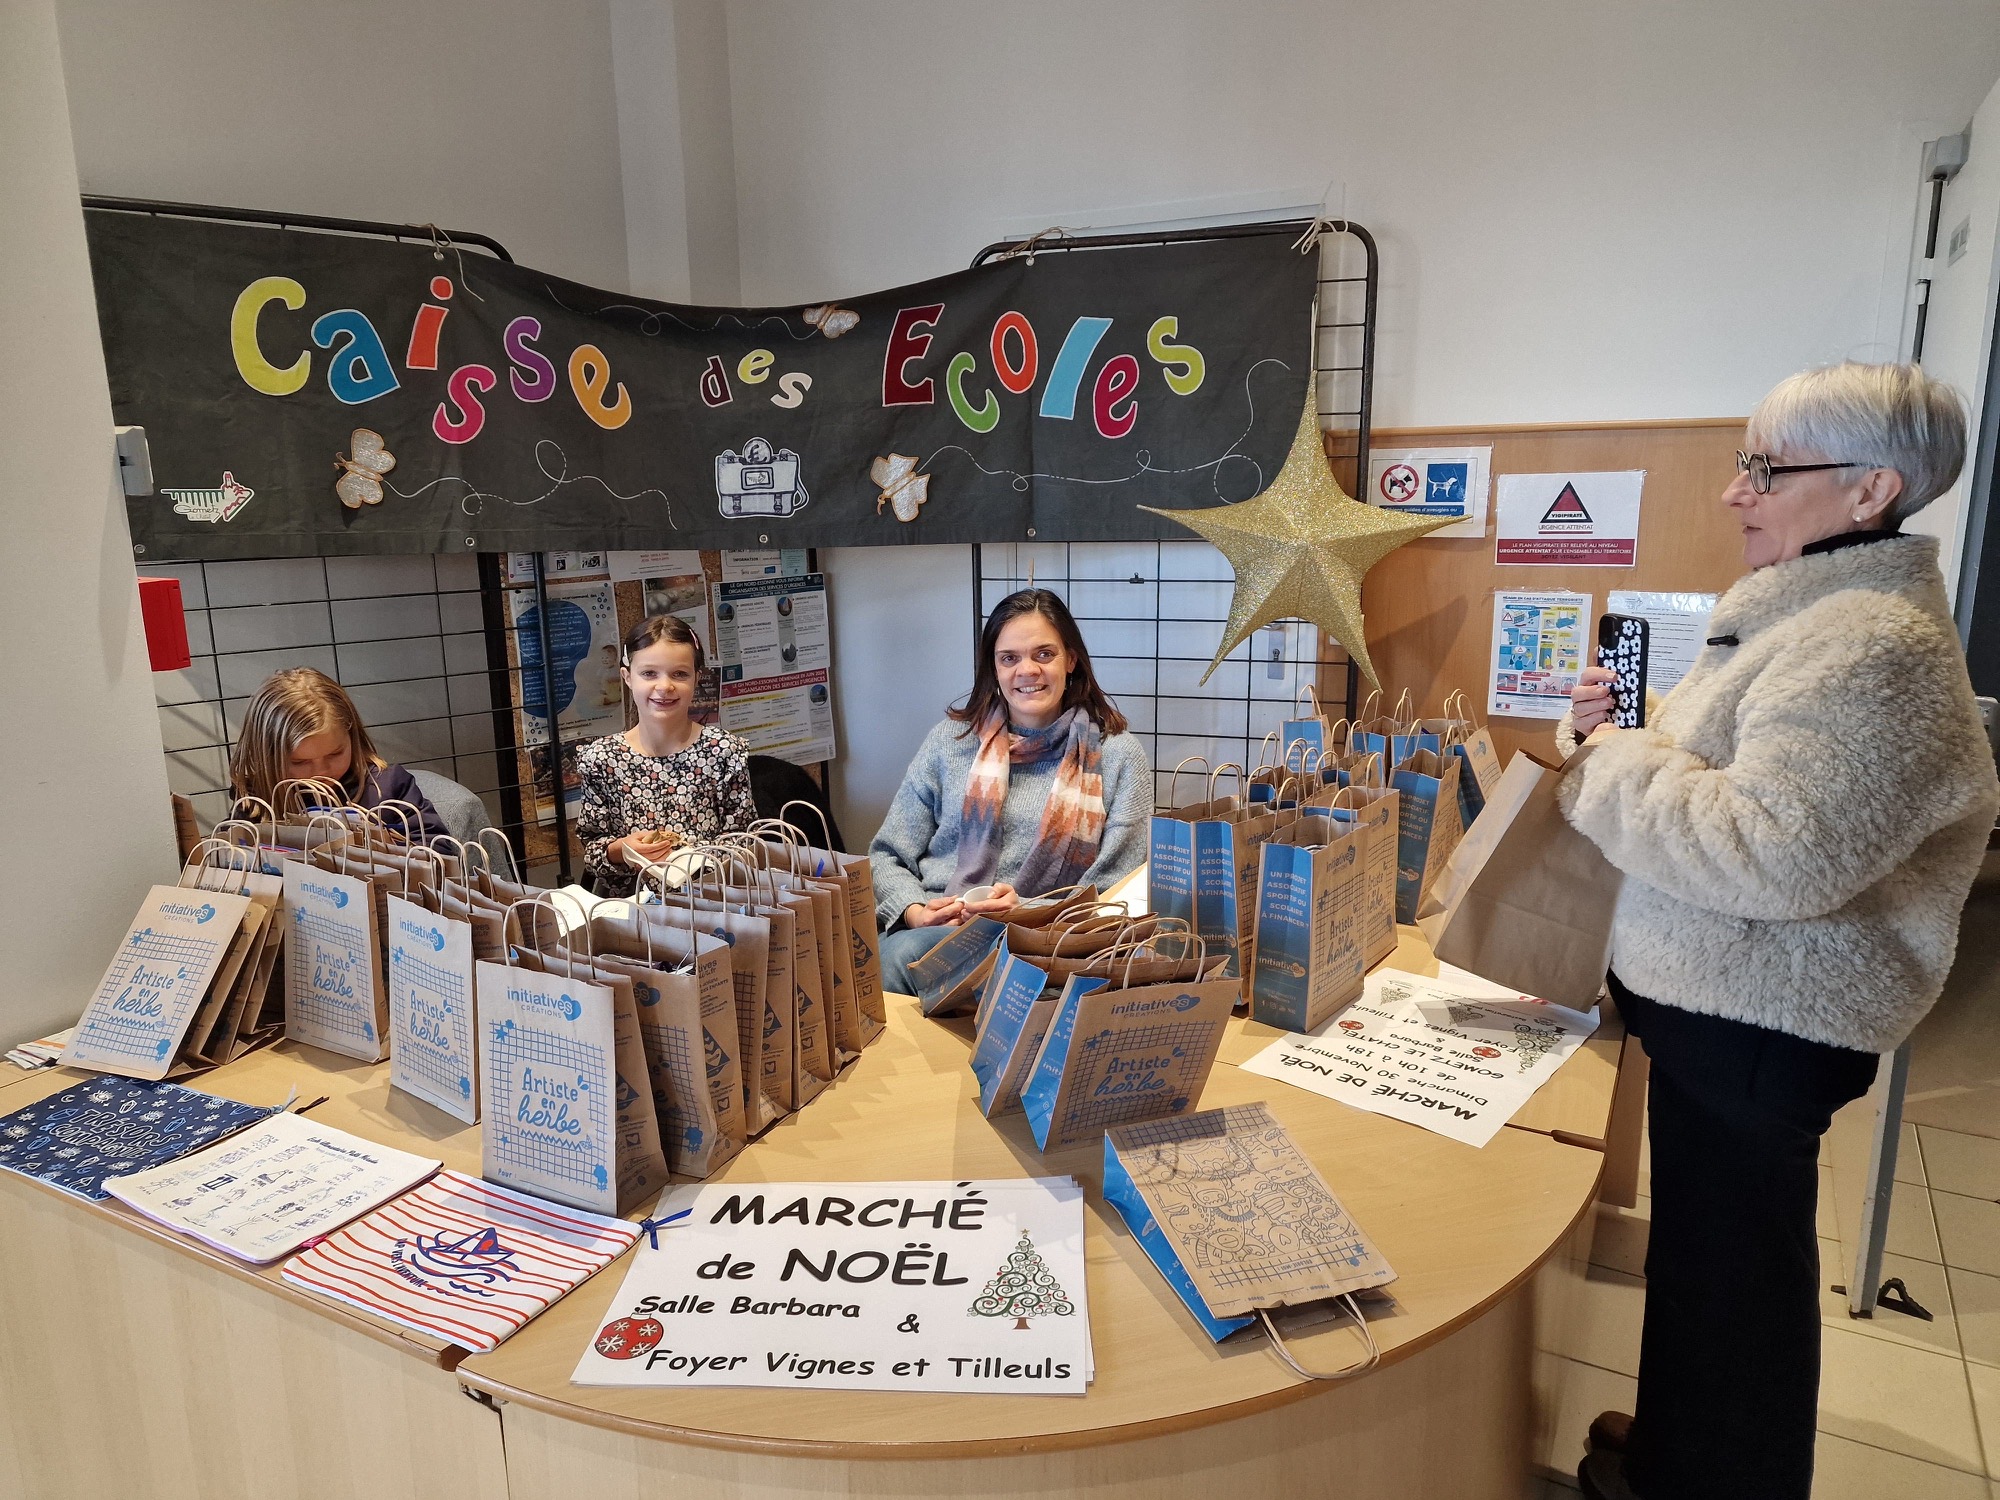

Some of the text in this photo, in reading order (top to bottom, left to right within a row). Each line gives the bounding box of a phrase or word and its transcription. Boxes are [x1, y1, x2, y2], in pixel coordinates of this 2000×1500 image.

[230, 275, 1206, 444] Caisse des Ecoles
[301, 880, 341, 903] initiatives
[159, 901, 209, 918] initiatives
[400, 917, 438, 944] initiatives
[316, 945, 351, 972] Artiste
[129, 964, 175, 990] Artiste
[313, 966, 354, 998] herbe
[328, 968, 339, 979] en
[1013, 980, 1026, 991] UN
[112, 987, 164, 1017] herbe
[138, 988, 150, 998] en
[410, 990, 445, 1022] Artiste
[507, 986, 572, 1014] initiatives
[1005, 993, 1029, 1010] SPOR
[1111, 998, 1190, 1015] initiatives
[422, 1017, 433, 1028] en
[521, 1003, 562, 1019] CRÉATIONS
[1124, 1008, 1172, 1019] CRÉATIONS
[410, 1013, 450, 1050] herbe
[1351, 1004, 1520, 1054] Foyer Vignes et Tilleuls
[1342, 1028, 1505, 1079] GOMETZ LE CHATEL
[1389, 1032, 1485, 1062] Salle Barbara
[1105, 1055, 1171, 1075] Artiste
[1295, 1043, 1489, 1107] Dimanche 30 Novembre
[1345, 1044, 1457, 1081] de 10h à 18h
[522, 1067, 578, 1102] Artiste
[1094, 1071, 1167, 1096] herbe
[1124, 1073, 1141, 1081] en
[1280, 1053, 1478, 1121] MARCHÉ DE NOËL
[517, 1094, 582, 1136] herbe
[541, 1097, 556, 1111] en
[69, 1109, 182, 1147] TRÉSORS
[709, 1190, 989, 1232] MARCHÉ
[697, 1241, 970, 1287] de NOËL
[639, 1294, 861, 1319] Salle Barbara
[896, 1312, 921, 1334] &
[644, 1349, 1072, 1380] Foyer Vignes et Tilleuls
